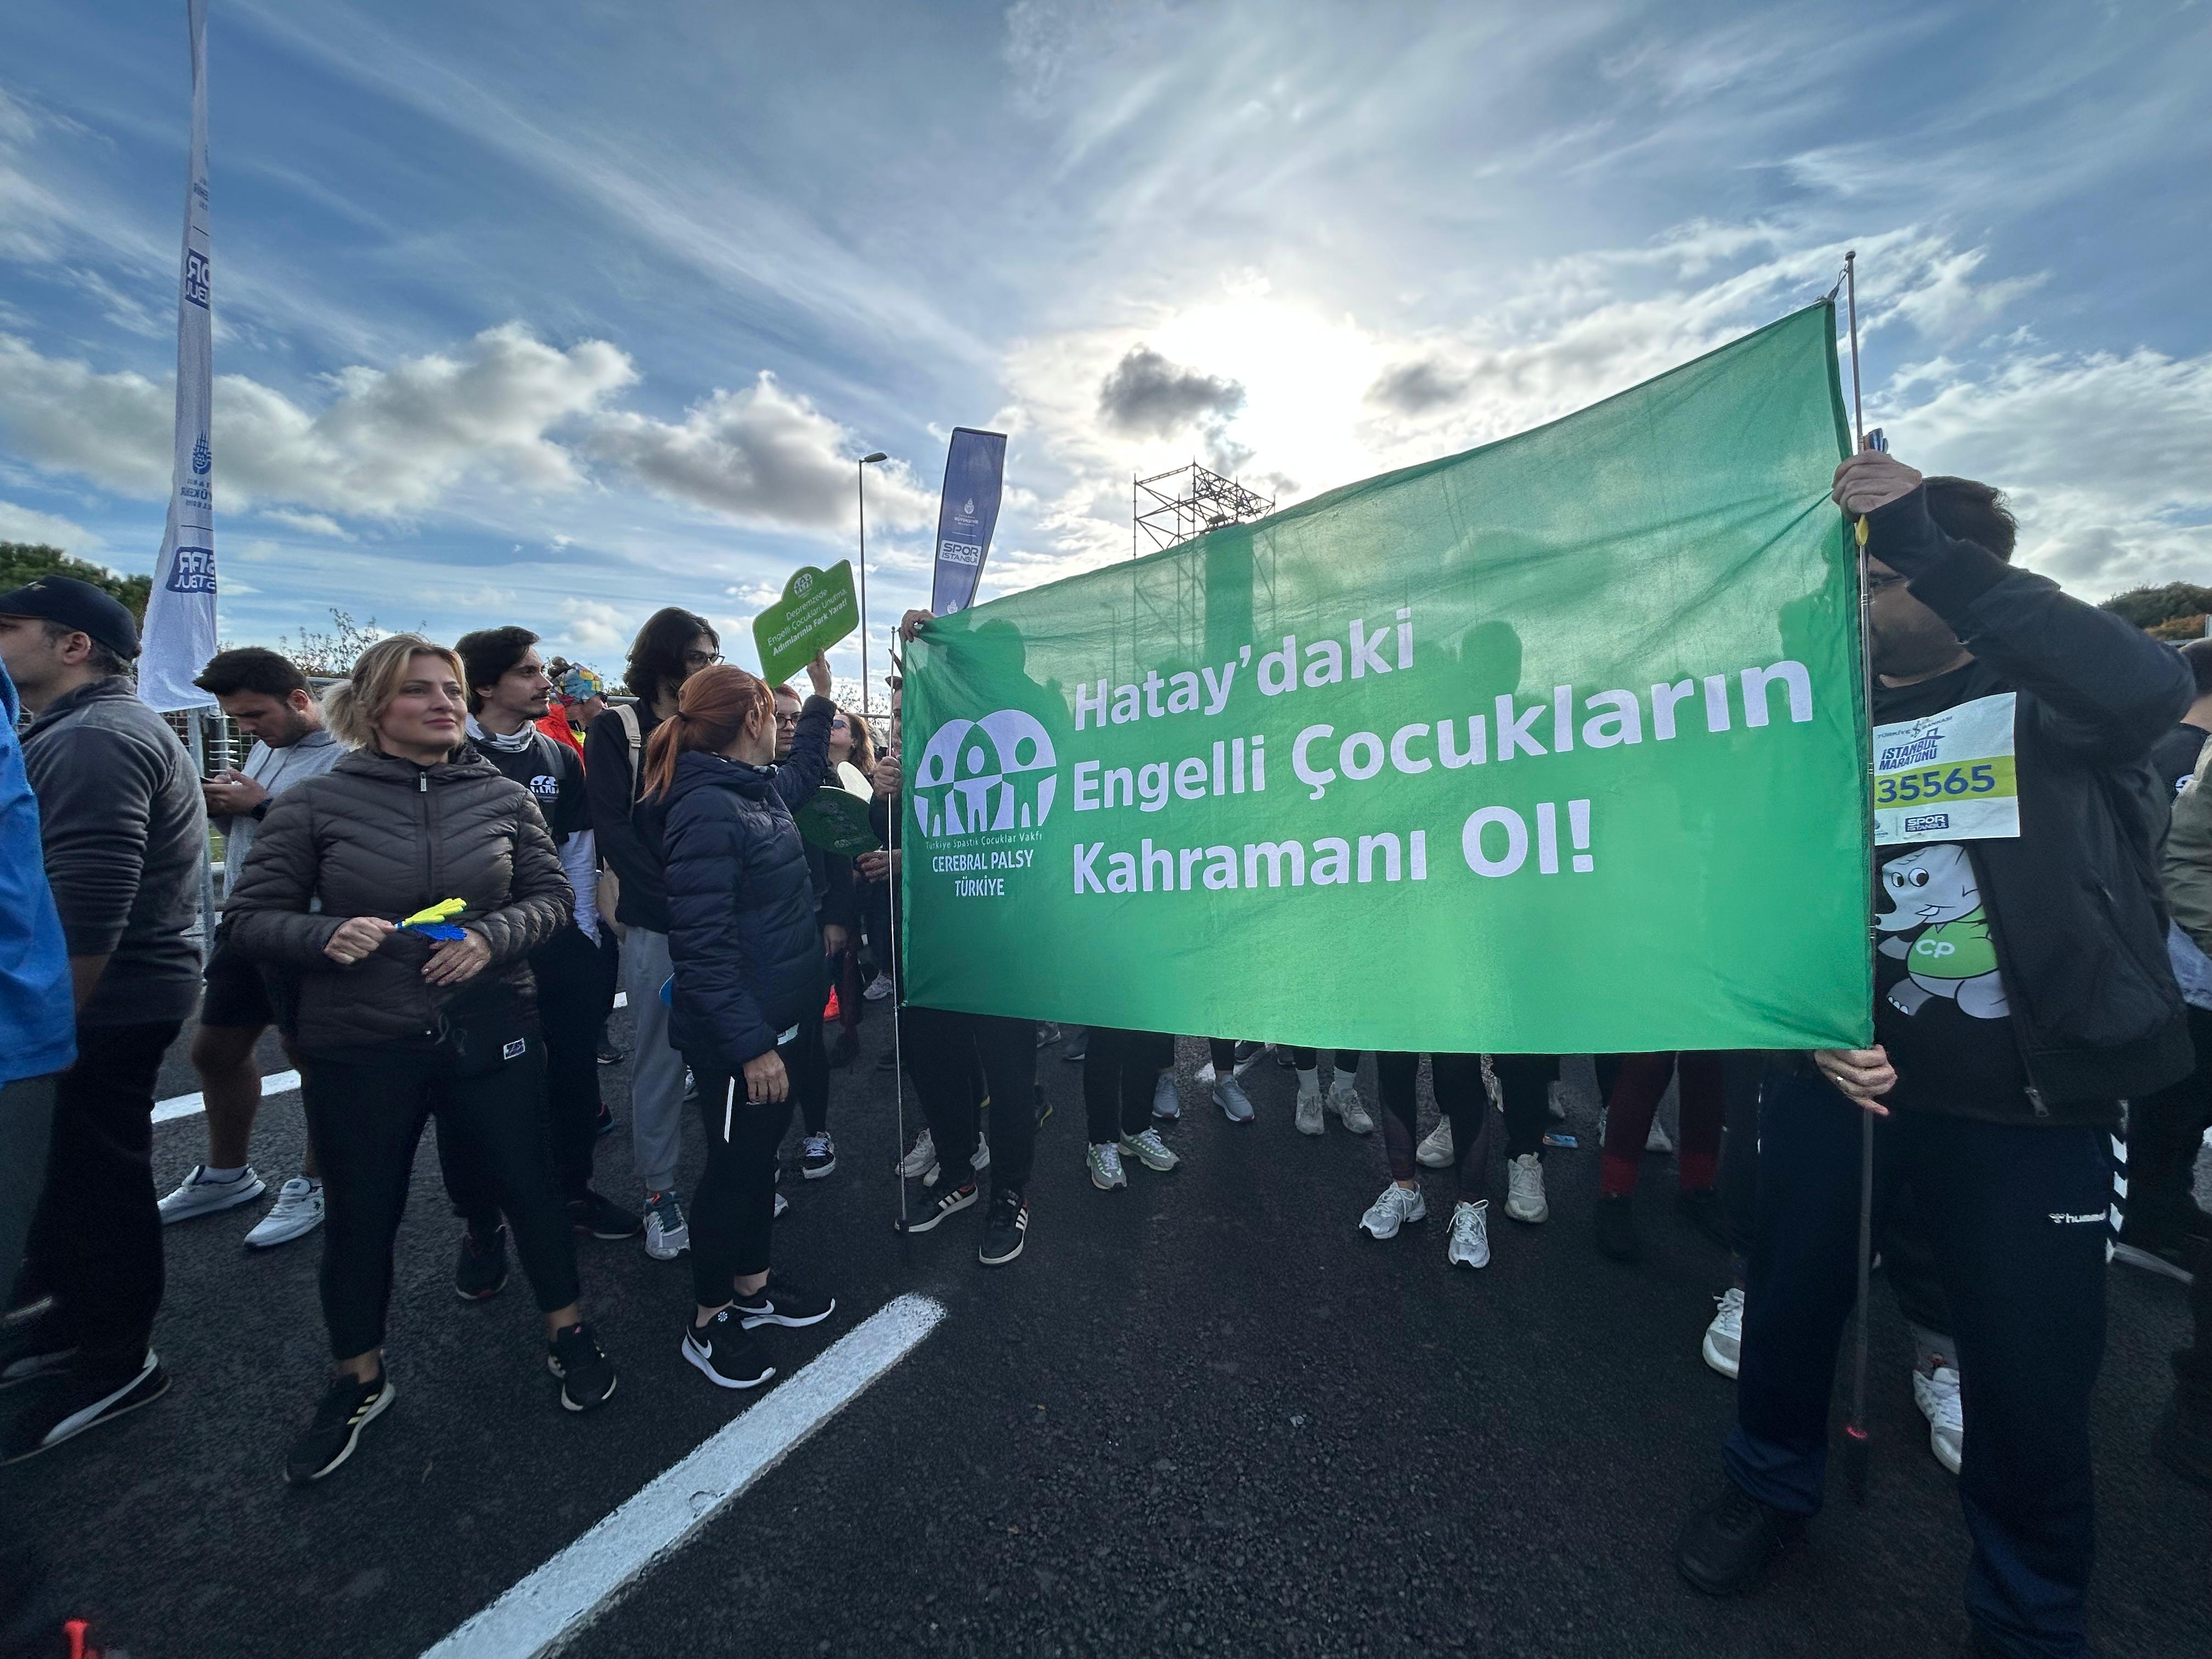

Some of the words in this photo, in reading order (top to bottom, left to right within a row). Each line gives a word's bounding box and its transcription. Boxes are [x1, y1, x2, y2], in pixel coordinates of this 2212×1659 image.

[943, 543, 979, 557] SPOR
[786, 589, 827, 620] Depremzede
[813, 613, 828, 628] Fark
[828, 598, 848, 616] Yarat!
[768, 625, 791, 646] Engelli
[1073, 734, 1266, 812] Engelli
[1291, 659, 1813, 800] Çocukların
[1878, 748, 1937, 770] MARATONU
[1877, 764, 1995, 803] 35565
[1907, 815, 1946, 826] SPOR
[981, 834, 1017, 847] Çocuklar
[1019, 831, 1042, 842] Vakfı
[1073, 830, 1427, 894] Kahramanı
[1462, 798, 1594, 878] Ol!
[932, 853, 988, 873] CEREBRAL
[991, 849, 1035, 870] PALSY
[955, 874, 1005, 897] TÜRKİYE
